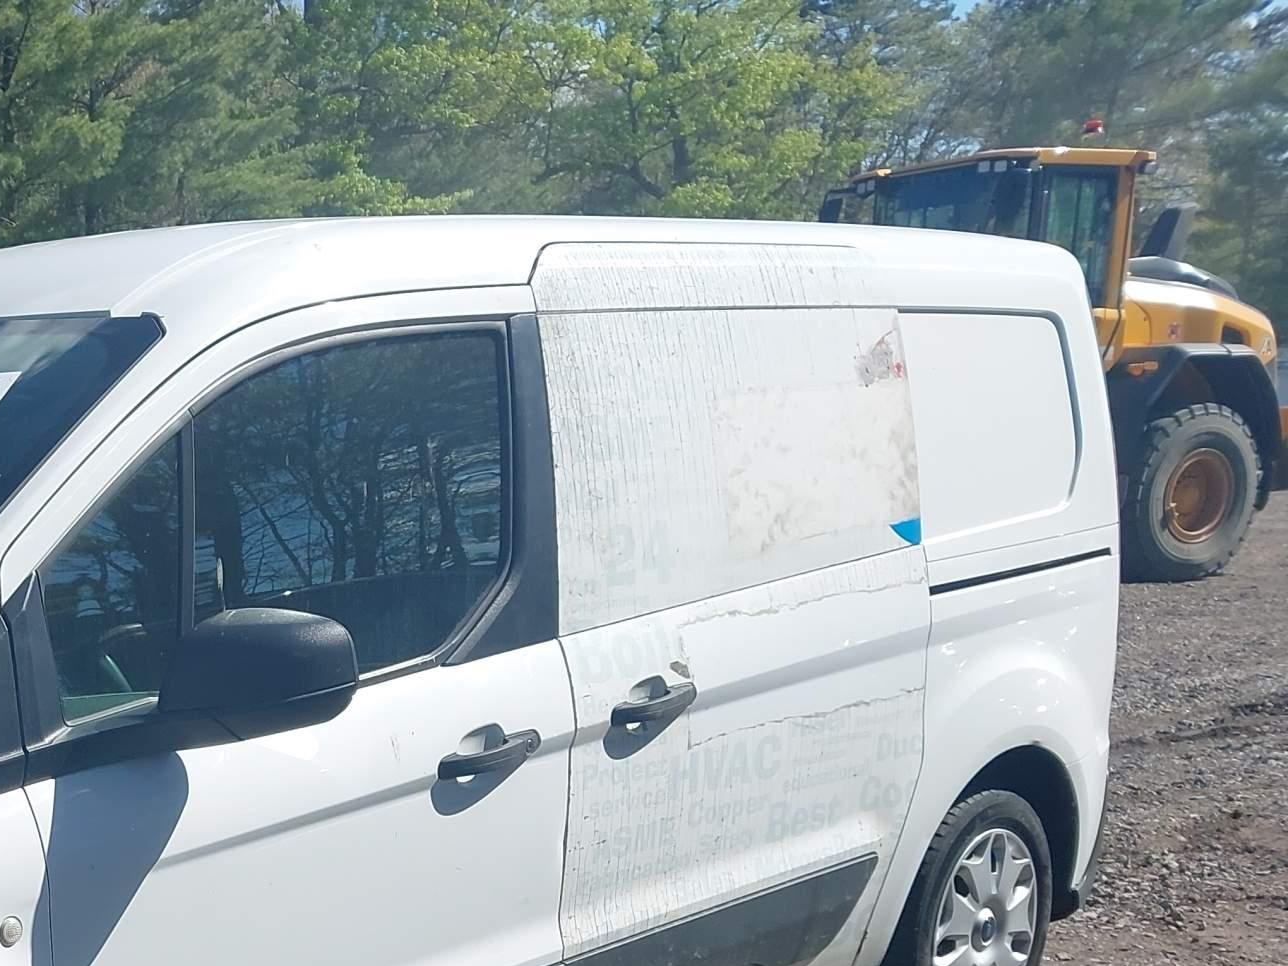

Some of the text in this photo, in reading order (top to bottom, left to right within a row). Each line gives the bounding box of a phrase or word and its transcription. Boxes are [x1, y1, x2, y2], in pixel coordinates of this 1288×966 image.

[582, 757, 668, 792] Project
[669, 734, 782, 802] HVAC
[588, 787, 667, 820] service
[687, 794, 770, 828] Copper
[765, 793, 842, 844] Best
